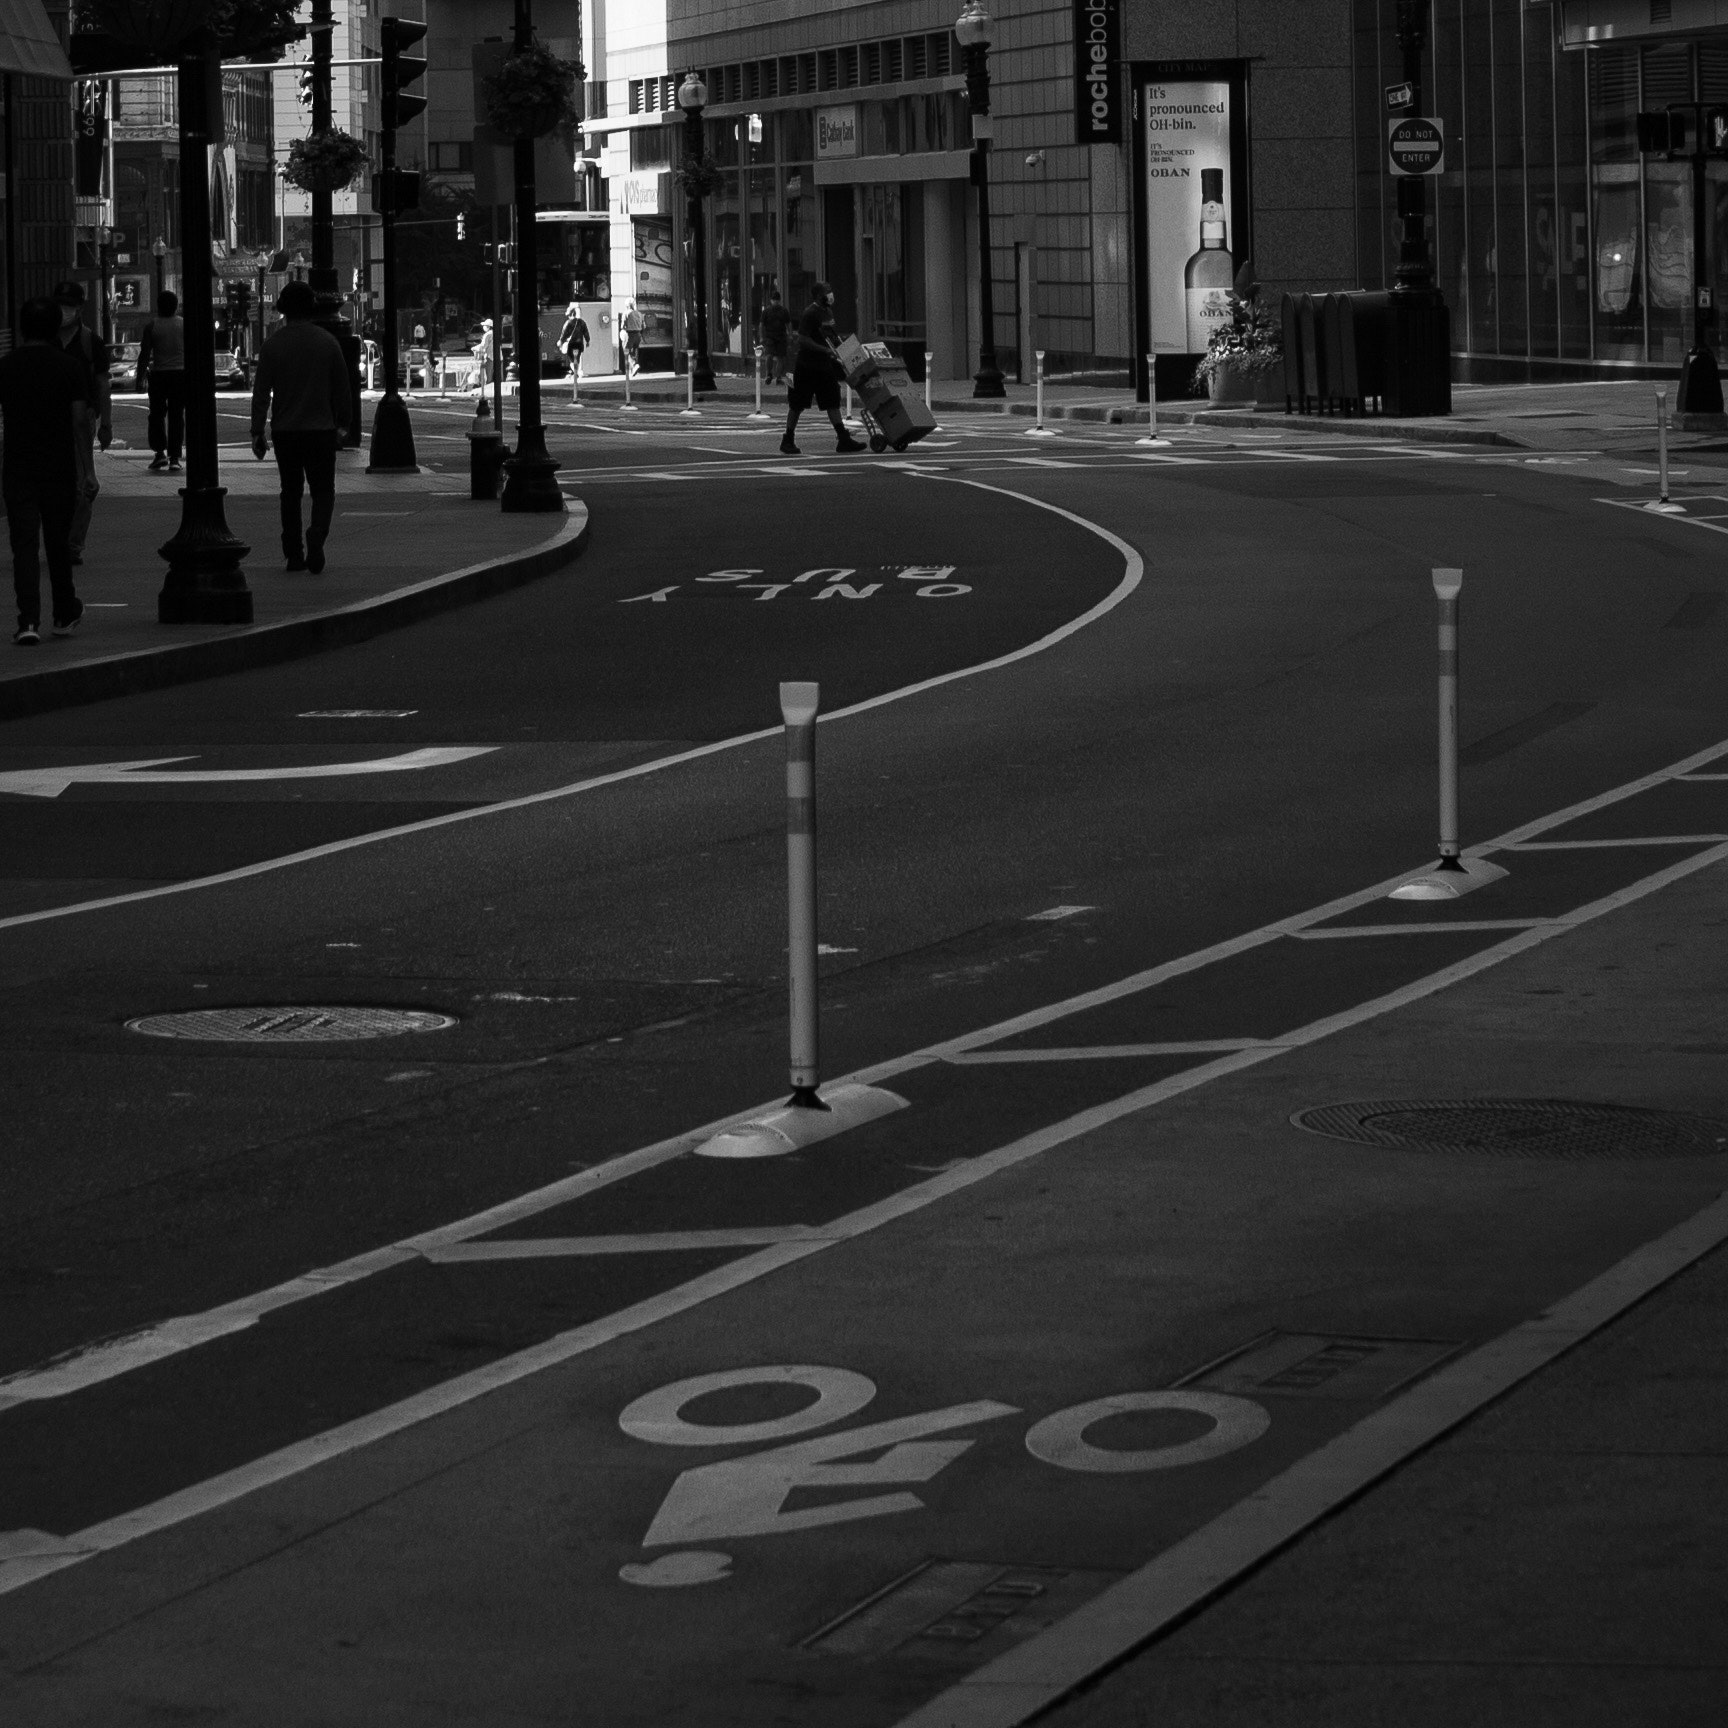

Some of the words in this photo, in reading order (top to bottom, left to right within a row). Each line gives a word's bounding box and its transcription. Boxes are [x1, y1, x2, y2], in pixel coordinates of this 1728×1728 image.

[1149, 87, 1166, 100] It's
[1149, 102, 1225, 117] pronounced
[1149, 118, 1197, 131] OH-bin.
[1398, 130, 1412, 140] DO
[1416, 130, 1434, 140] NOT
[1401, 153, 1432, 163] ENTER
[1150, 168, 1191, 178] OBAN
[694, 567, 957, 582] BUS
[616, 583, 972, 603] ONLY
